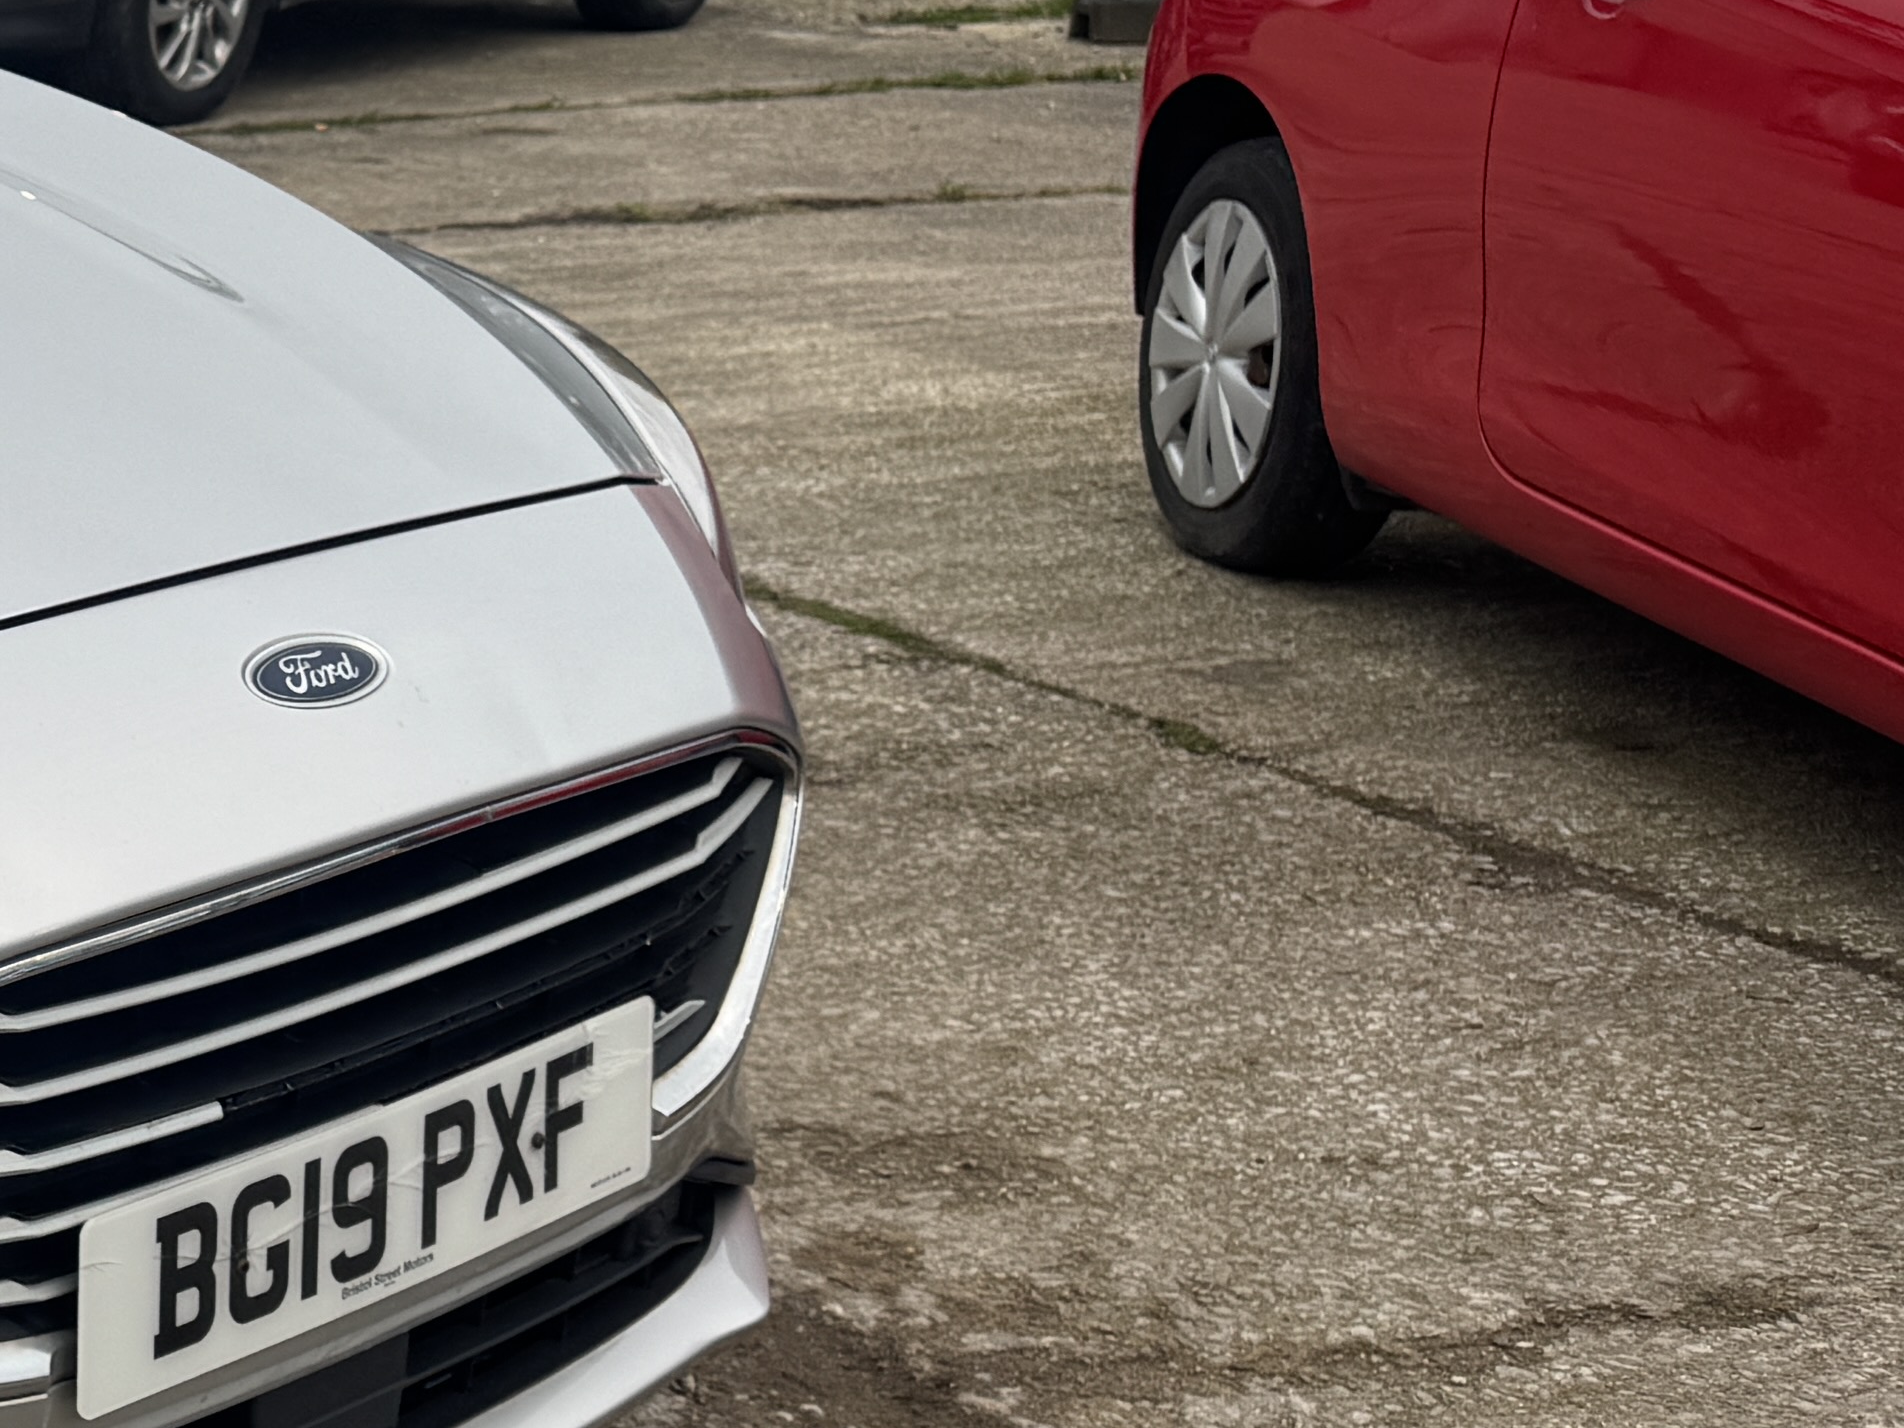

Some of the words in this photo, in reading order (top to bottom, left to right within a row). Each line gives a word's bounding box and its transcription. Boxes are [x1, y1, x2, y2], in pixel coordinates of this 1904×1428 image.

[278, 650, 359, 694] Ford
[153, 1135, 389, 1360] BG19
[421, 1041, 594, 1250] PXF
